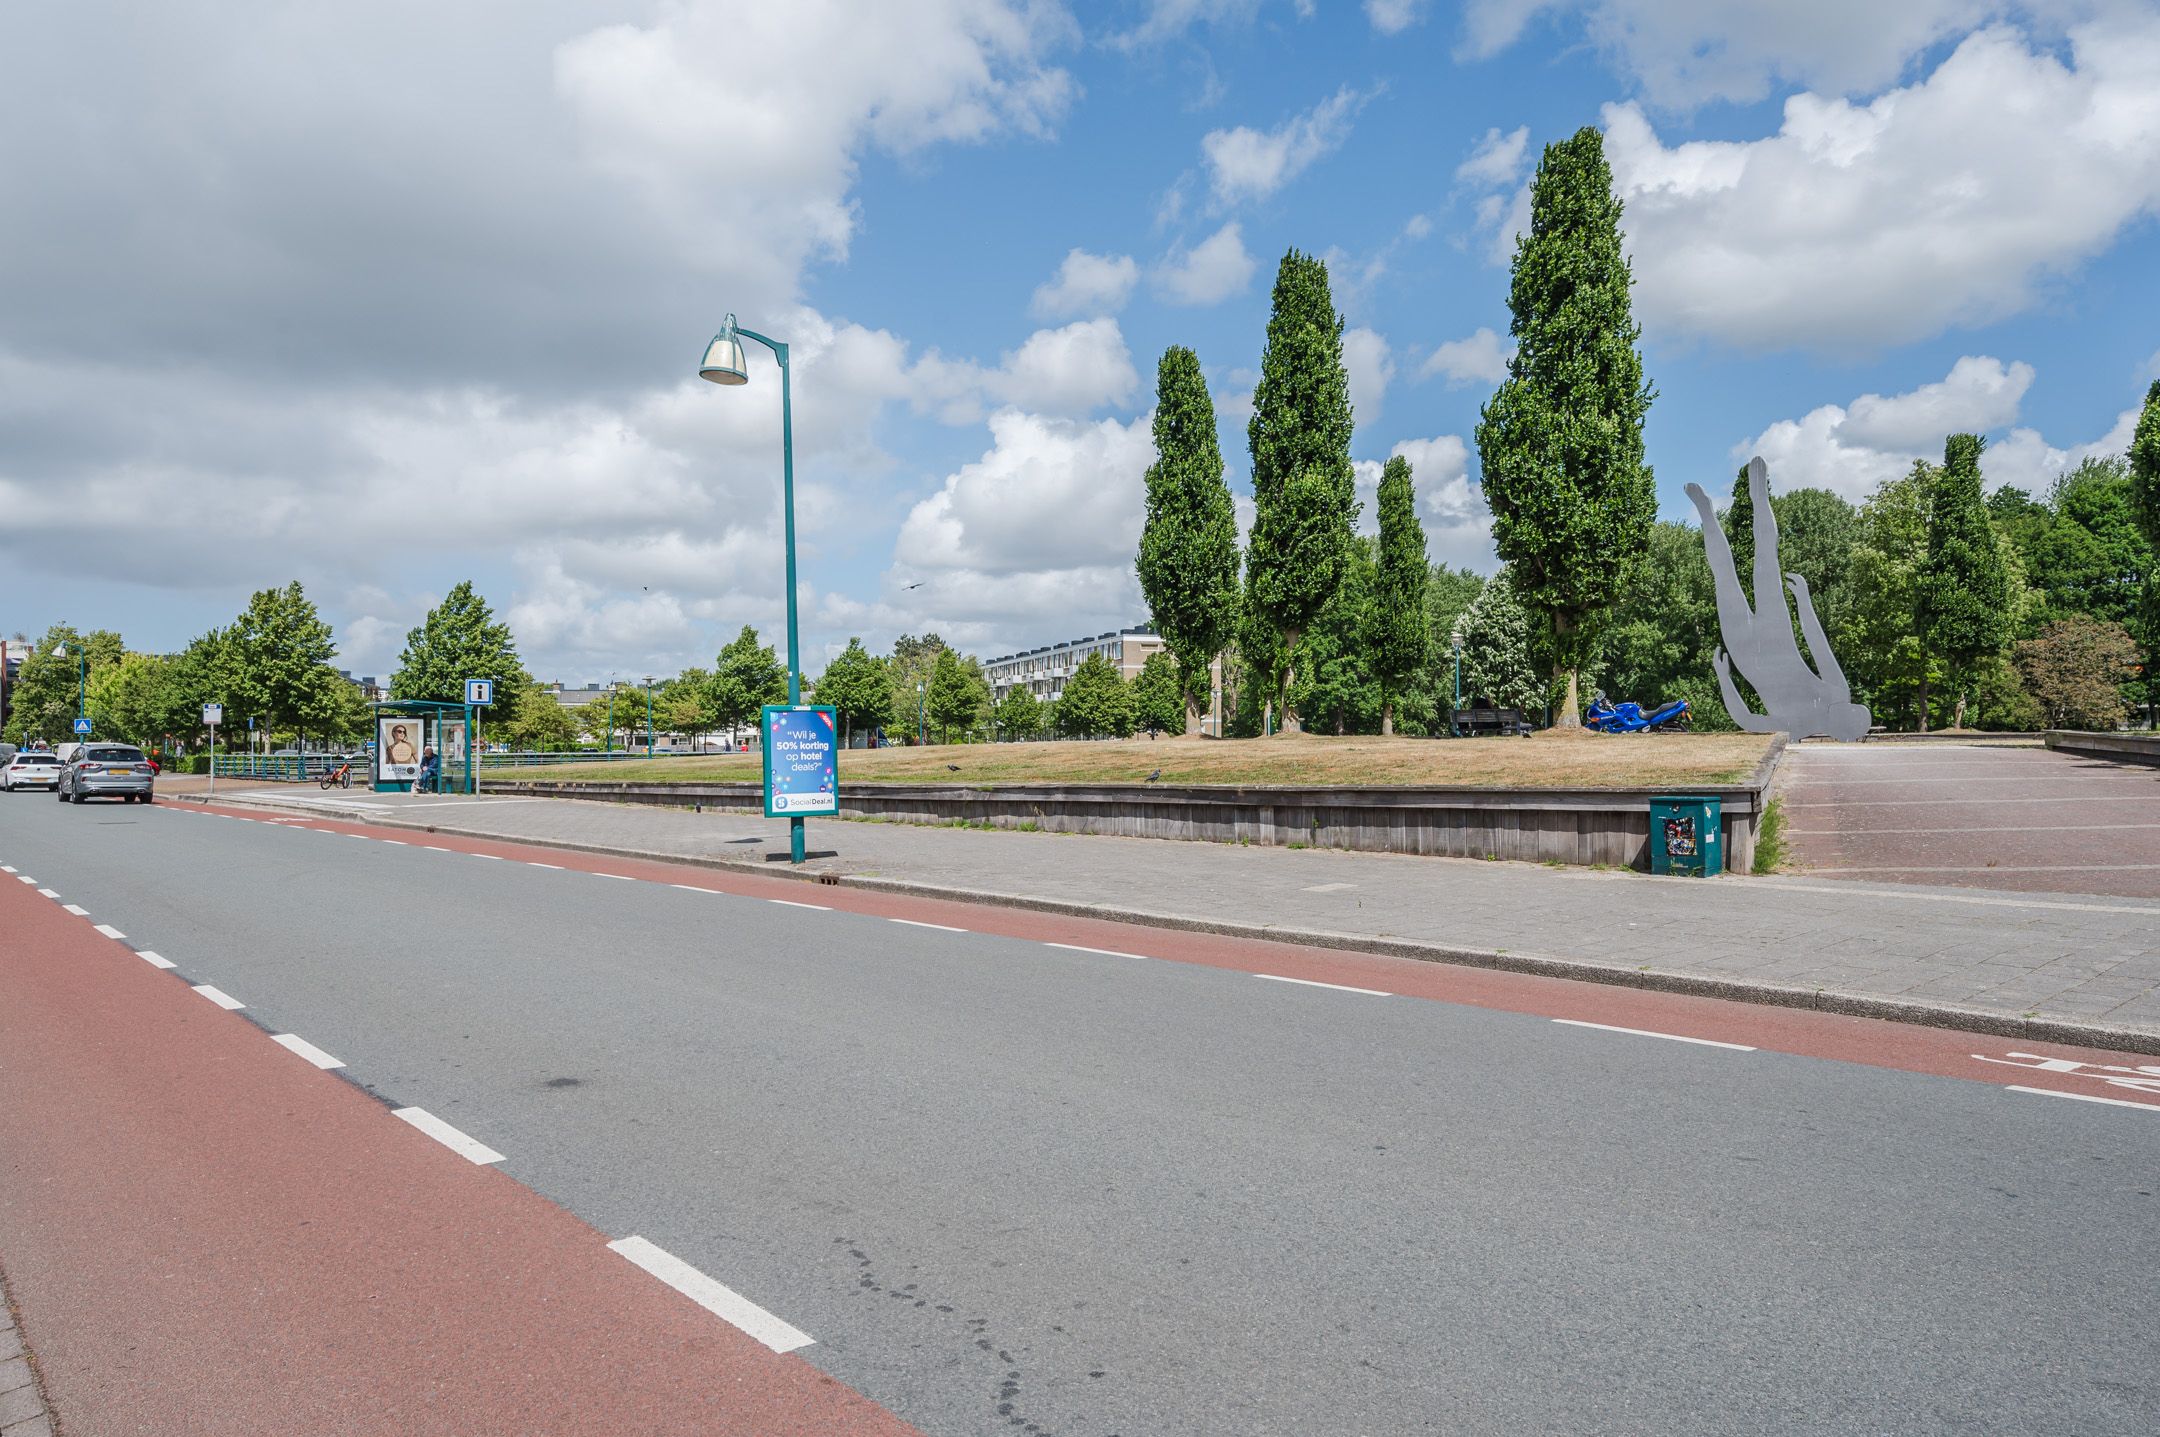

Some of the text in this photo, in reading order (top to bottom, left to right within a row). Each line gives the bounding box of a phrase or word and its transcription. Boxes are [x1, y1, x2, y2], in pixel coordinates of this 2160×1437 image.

[808, 730, 817, 740] je
[776, 741, 829, 751] 50% korting
[785, 751, 822, 761] op hotel
[790, 797, 833, 806] SocialDeal.nl
